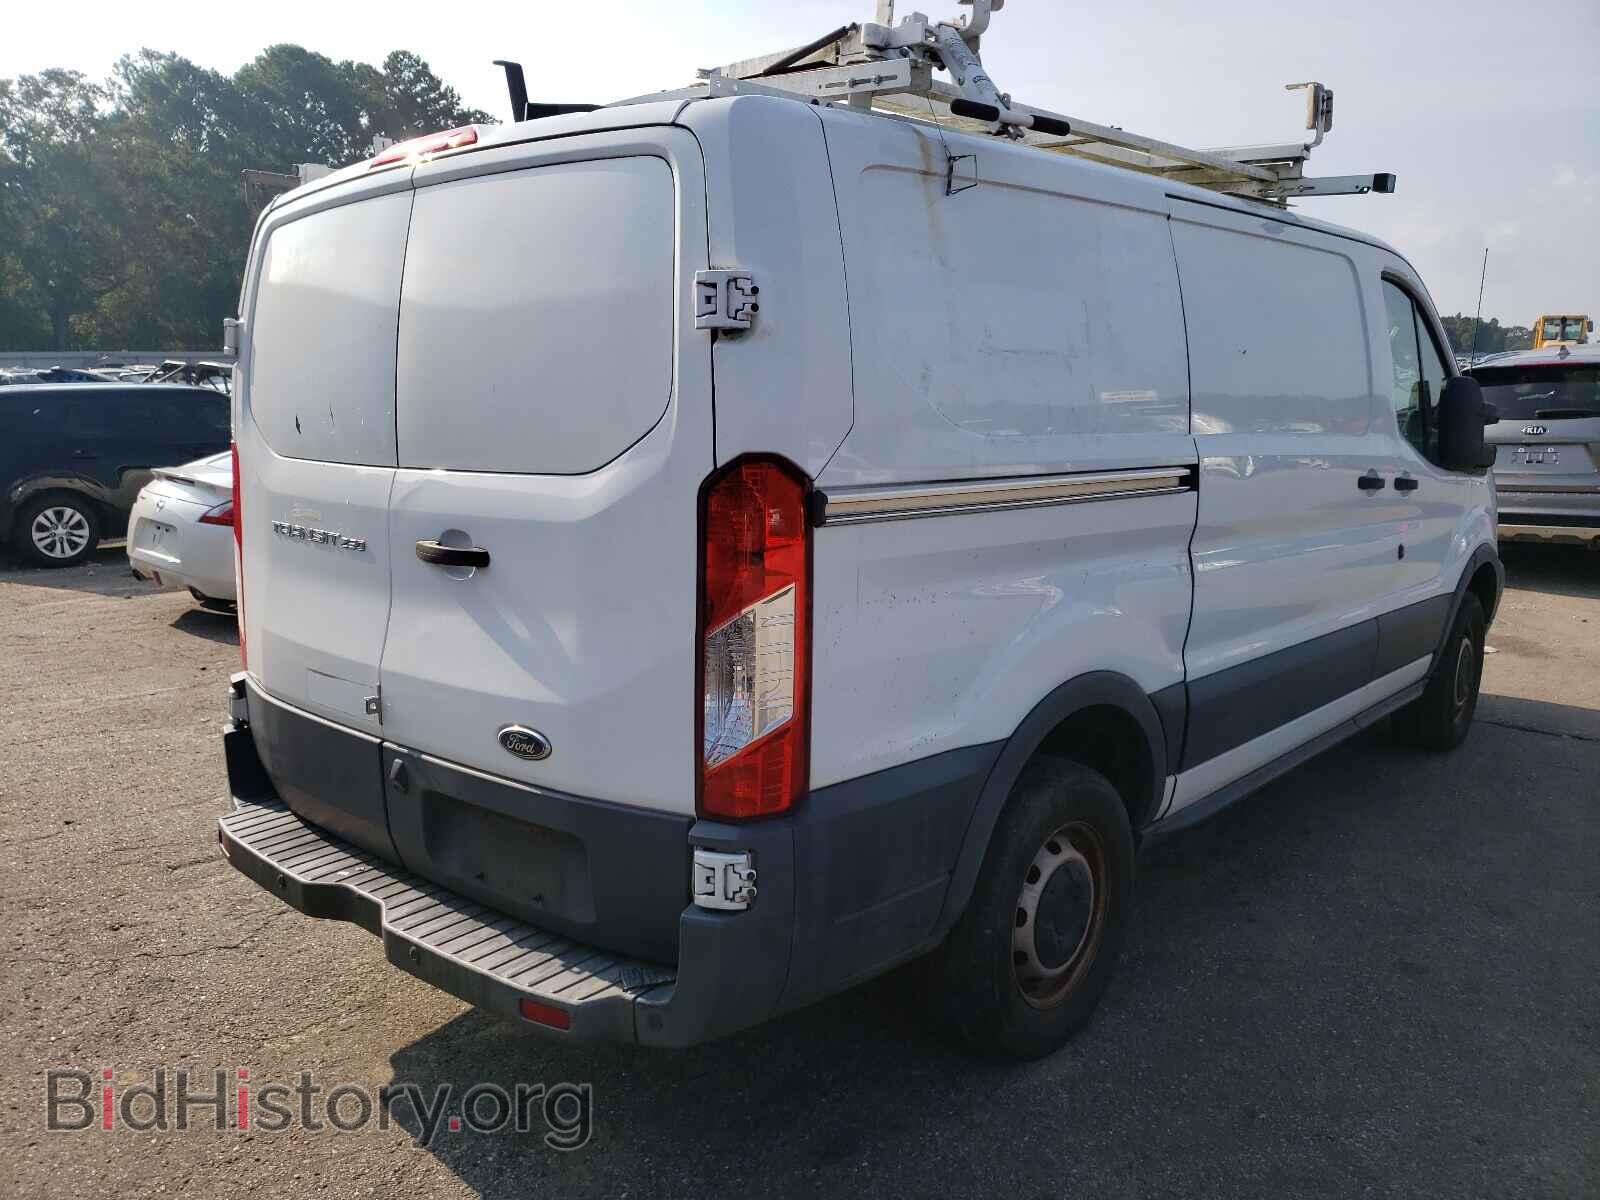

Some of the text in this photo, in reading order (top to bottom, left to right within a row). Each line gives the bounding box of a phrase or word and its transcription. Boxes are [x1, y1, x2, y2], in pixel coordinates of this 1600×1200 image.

[1526, 425, 1545, 434] KIA
[271, 520, 341, 545] TRANSIT
[506, 733, 536, 754] Ford
